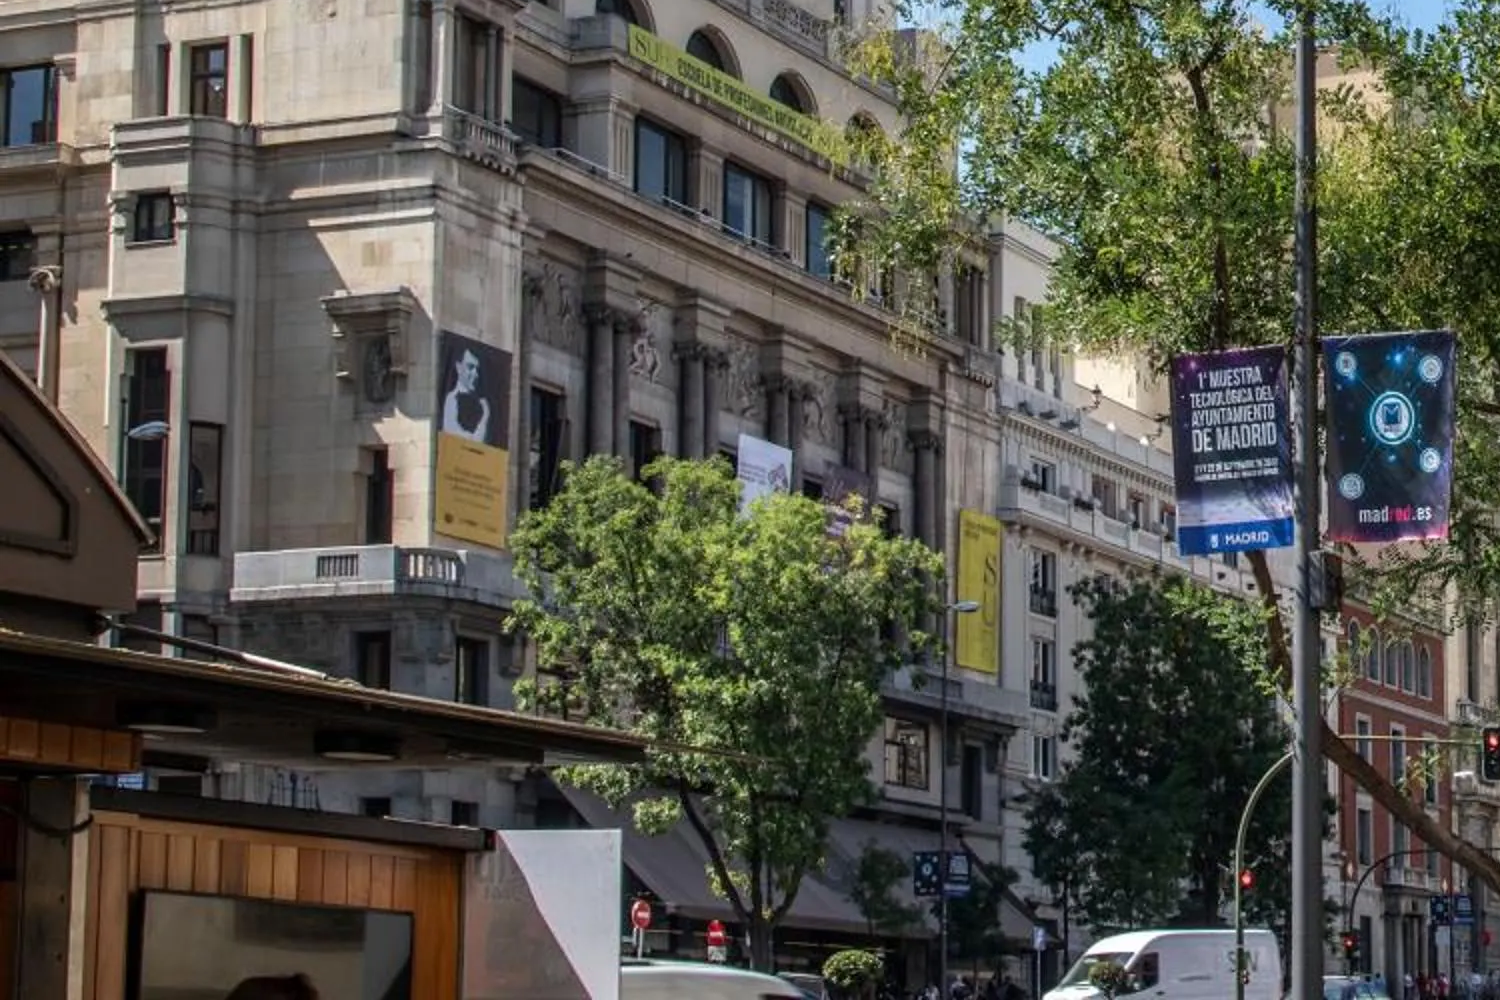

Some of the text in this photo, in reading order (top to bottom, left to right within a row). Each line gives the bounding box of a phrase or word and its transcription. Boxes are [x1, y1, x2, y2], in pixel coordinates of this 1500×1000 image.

[1209, 365, 1263, 389] MUESTRA
[1255, 385, 1275, 401] DEL
[1191, 402, 1275, 427] AYUNTAMIENTO
[1191, 421, 1277, 453] DE MADRID
[1225, 531, 1269, 545] MADRID
